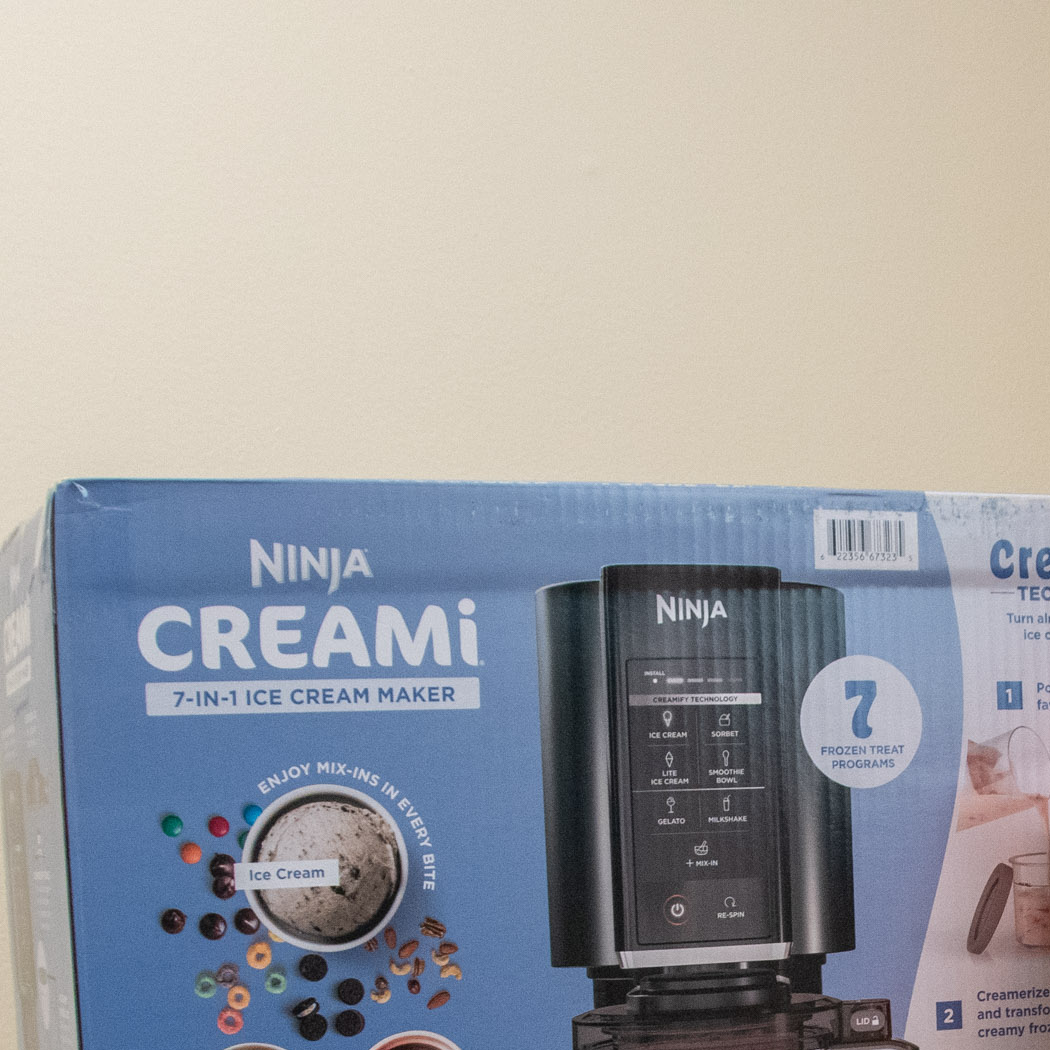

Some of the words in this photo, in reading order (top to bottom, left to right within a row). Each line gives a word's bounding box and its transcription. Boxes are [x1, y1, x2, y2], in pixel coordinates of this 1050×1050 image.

[837, 552, 865, 561] 22356
[869, 552, 897, 561] 67323
[249, 538, 374, 595] NINJA
[656, 594, 728, 628] NINJA
[1006, 612, 1035, 624] Turn
[1022, 629, 1042, 641] ice
[172, 691, 237, 708] 7-IN-1
[246, 690, 282, 706] ICE
[290, 688, 370, 705] CREAM
[378, 686, 455, 703] MAKER
[691, 695, 738, 703] TECHNOLOGY
[1005, 689, 1013, 703] 1
[844, 680, 877, 740] 7
[662, 731, 688, 739] CREAM
[711, 730, 739, 738] SORBET
[820, 745, 867, 756] FROZEN
[869, 744, 905, 755] TREAT
[831, 758, 895, 770] PROGRAMS
[708, 768, 745, 776] SMOOTHIE
[708, 815, 748, 823] MILKSHAKE
[257, 763, 311, 795] ENJOY
[317, 761, 381, 787] MIX-INS
[380, 781, 400, 800] IN
[397, 798, 433, 848] EVERY
[422, 853, 436, 891] BITE
[249, 868, 272, 882] Ice
[276, 866, 325, 881] Cream
[717, 910, 745, 919] RE-SPIN
[943, 1009, 954, 1024] 2
[977, 1007, 1001, 1020] and
[856, 1017, 870, 1026] LID
[978, 1026, 1025, 1038] creamy
